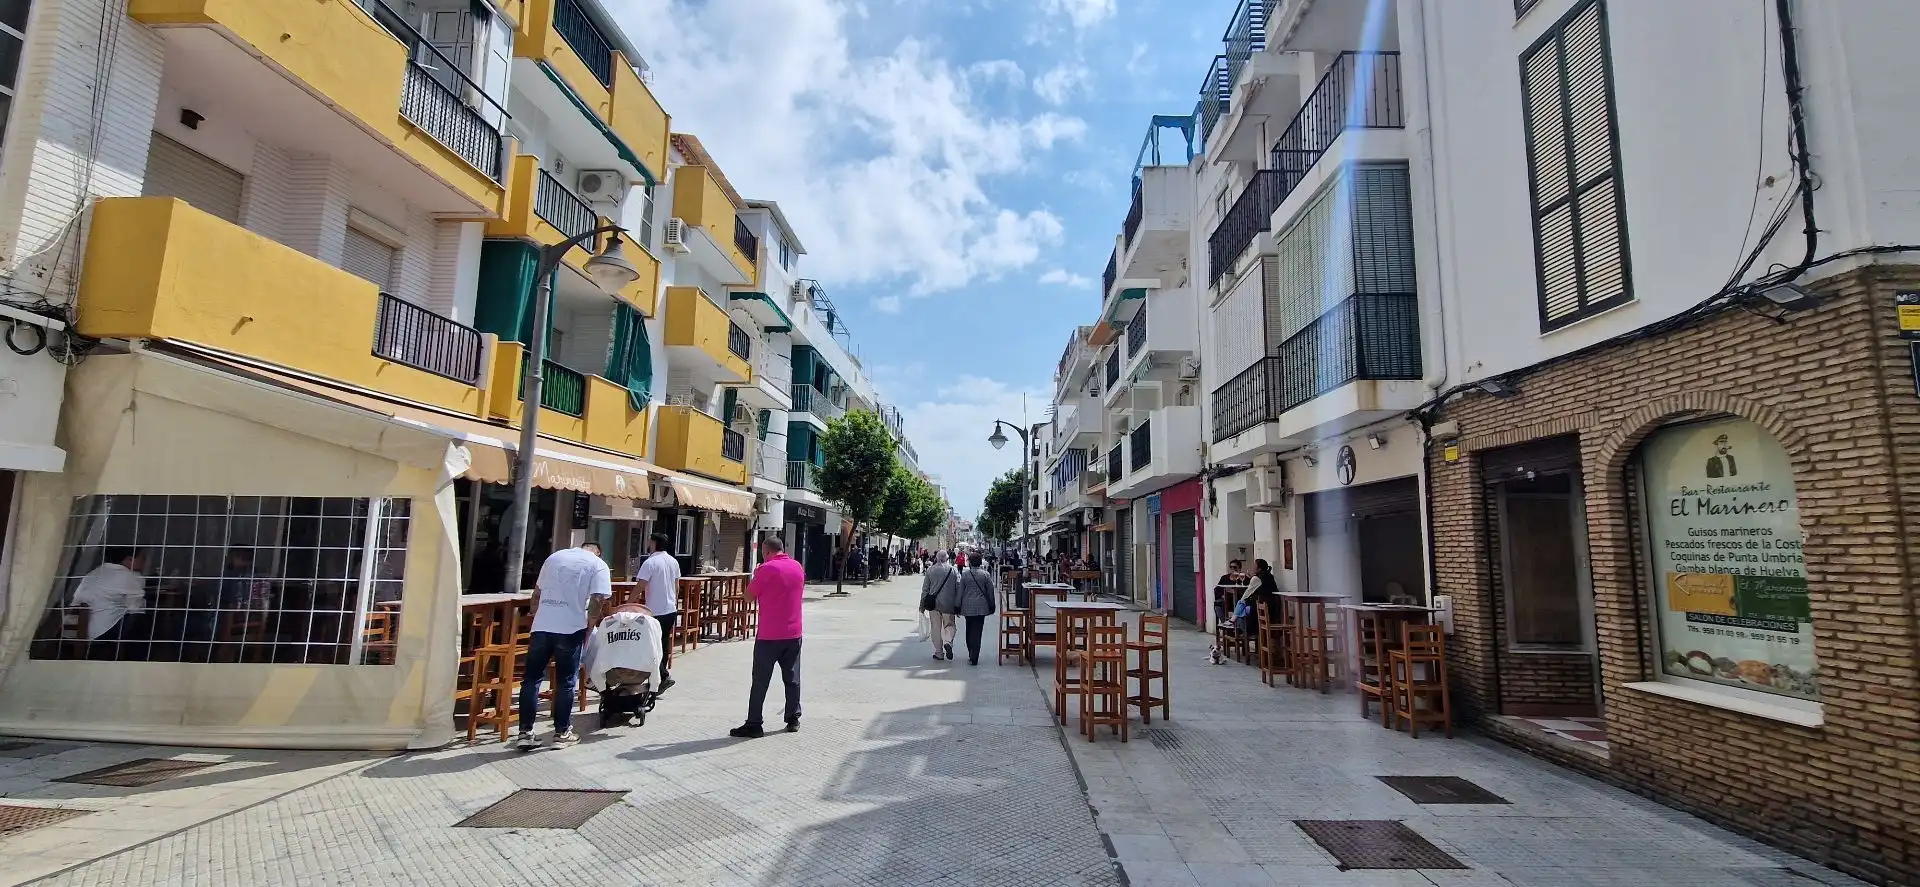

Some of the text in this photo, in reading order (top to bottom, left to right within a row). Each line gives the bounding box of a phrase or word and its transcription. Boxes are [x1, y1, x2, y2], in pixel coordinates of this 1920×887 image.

[1681, 482, 1771, 496] Bar-Restaurante
[1670, 497, 1789, 516] El Marinero
[1687, 527, 1773, 537] Guisos marineros
[1665, 540, 1705, 549] Pescados
[1707, 540, 1742, 549] frescos
[1745, 540, 1759, 549] de
[1762, 539, 1772, 549] la
[1670, 551, 1710, 563] Coquinas
[1713, 552, 1725, 561] de
[1728, 552, 1758, 562] Punta
[1675, 563, 1800, 577] Gamba blanca de Huelva
[1715, 615, 1726, 623] DE
[1728, 616, 1796, 631] CELEBRACIONES
